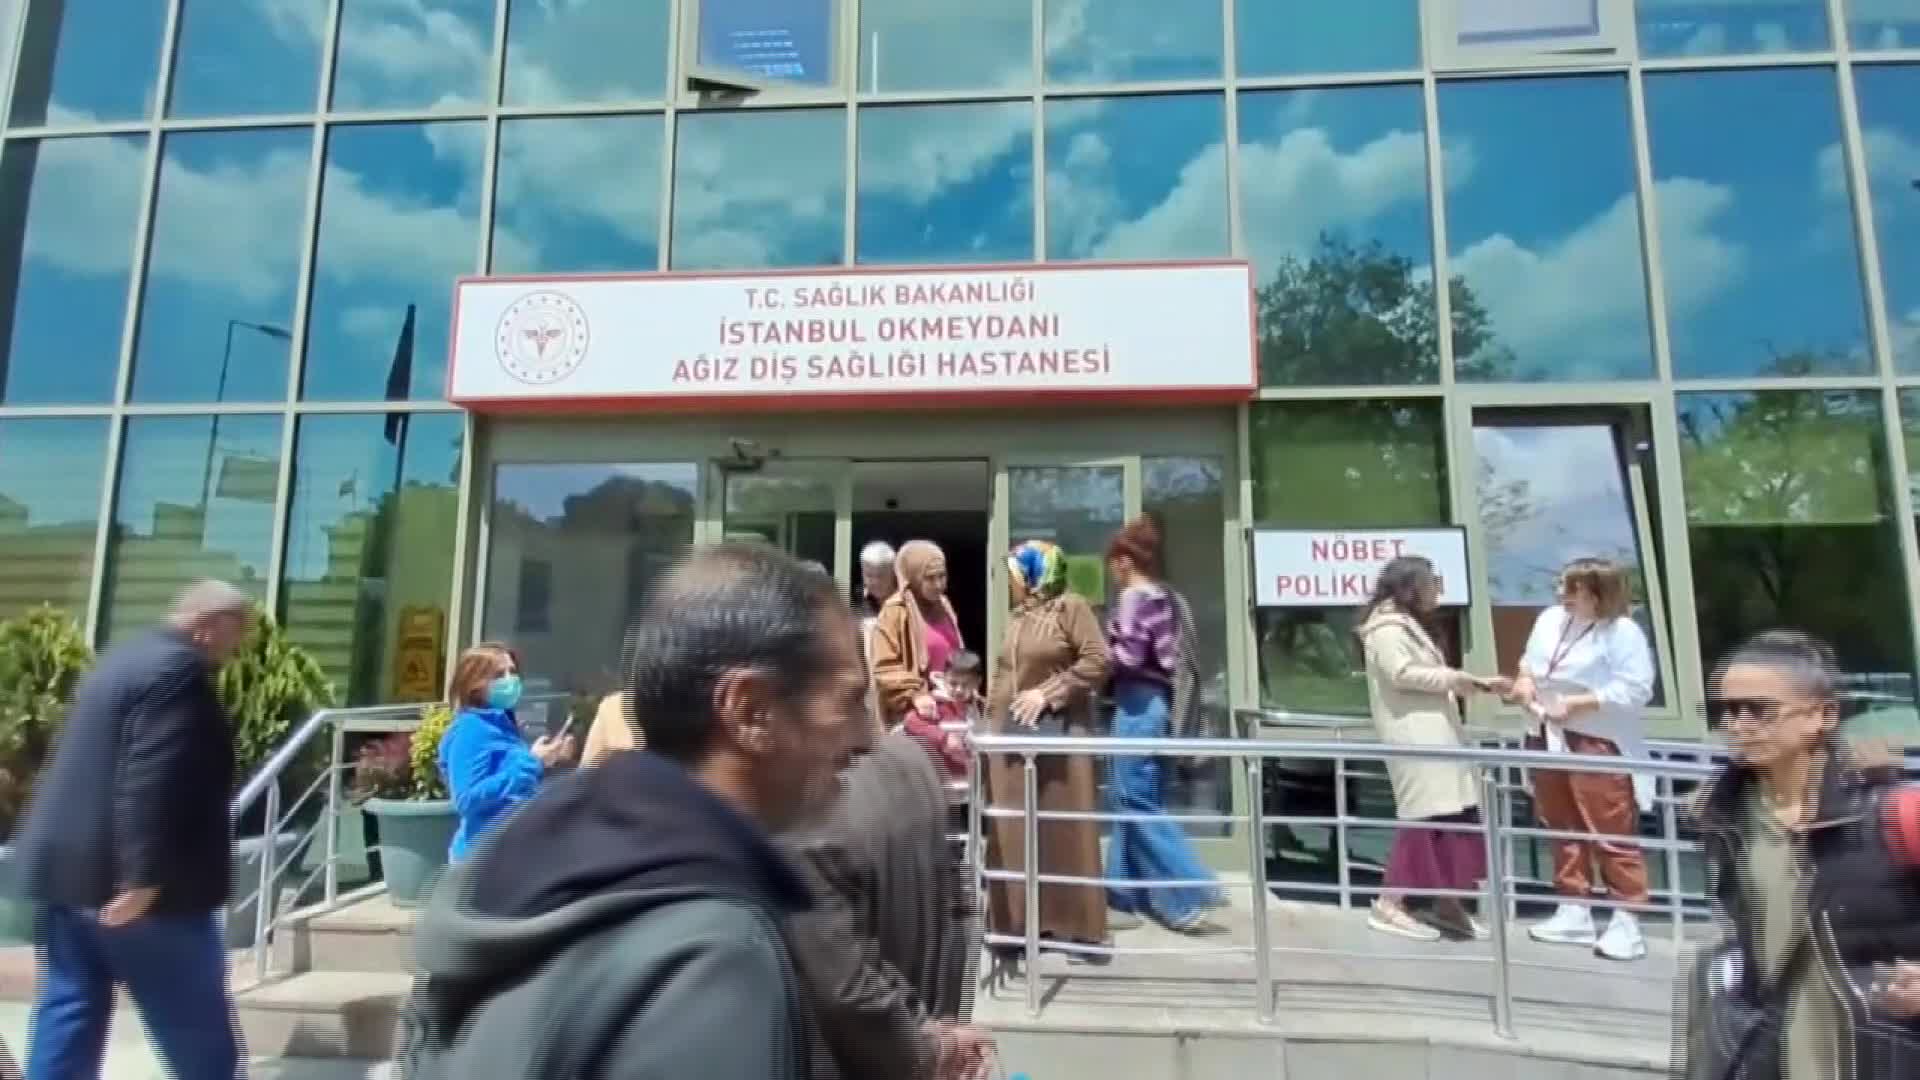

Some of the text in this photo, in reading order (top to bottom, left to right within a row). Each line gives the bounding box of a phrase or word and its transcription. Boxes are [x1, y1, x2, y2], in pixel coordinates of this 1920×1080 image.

[744, 276, 1035, 309] T.C. SAĞLIK BAKANLIĞI
[719, 313, 1060, 346] İSTANBUL OKMEYDANI
[672, 344, 1111, 385] AĞIZ DİŞ SAĞLIĞI HASTANESİ
[1311, 533, 1406, 561] NÖBET
